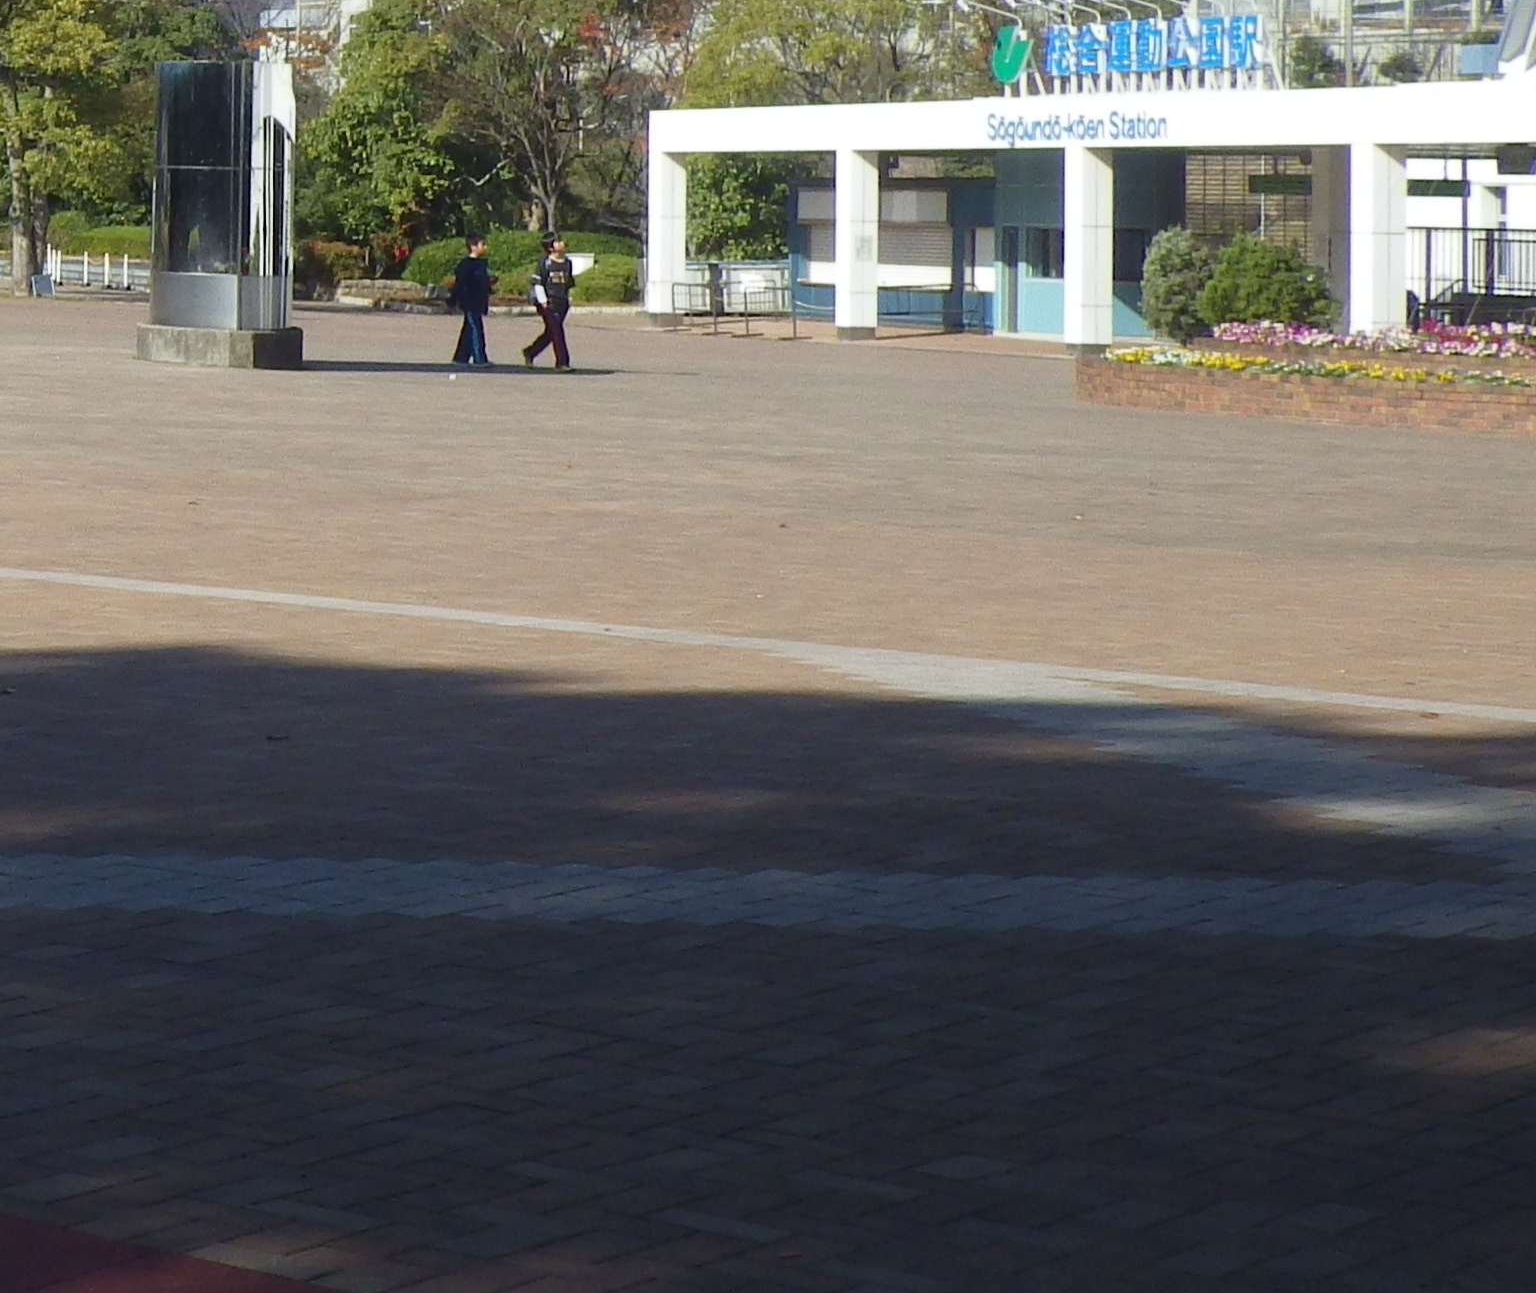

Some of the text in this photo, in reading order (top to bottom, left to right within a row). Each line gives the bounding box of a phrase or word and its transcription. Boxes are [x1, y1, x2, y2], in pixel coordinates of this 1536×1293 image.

[1045, 15, 1260, 76] 総合運動公園駅
[1109, 110, 1168, 140] Station
